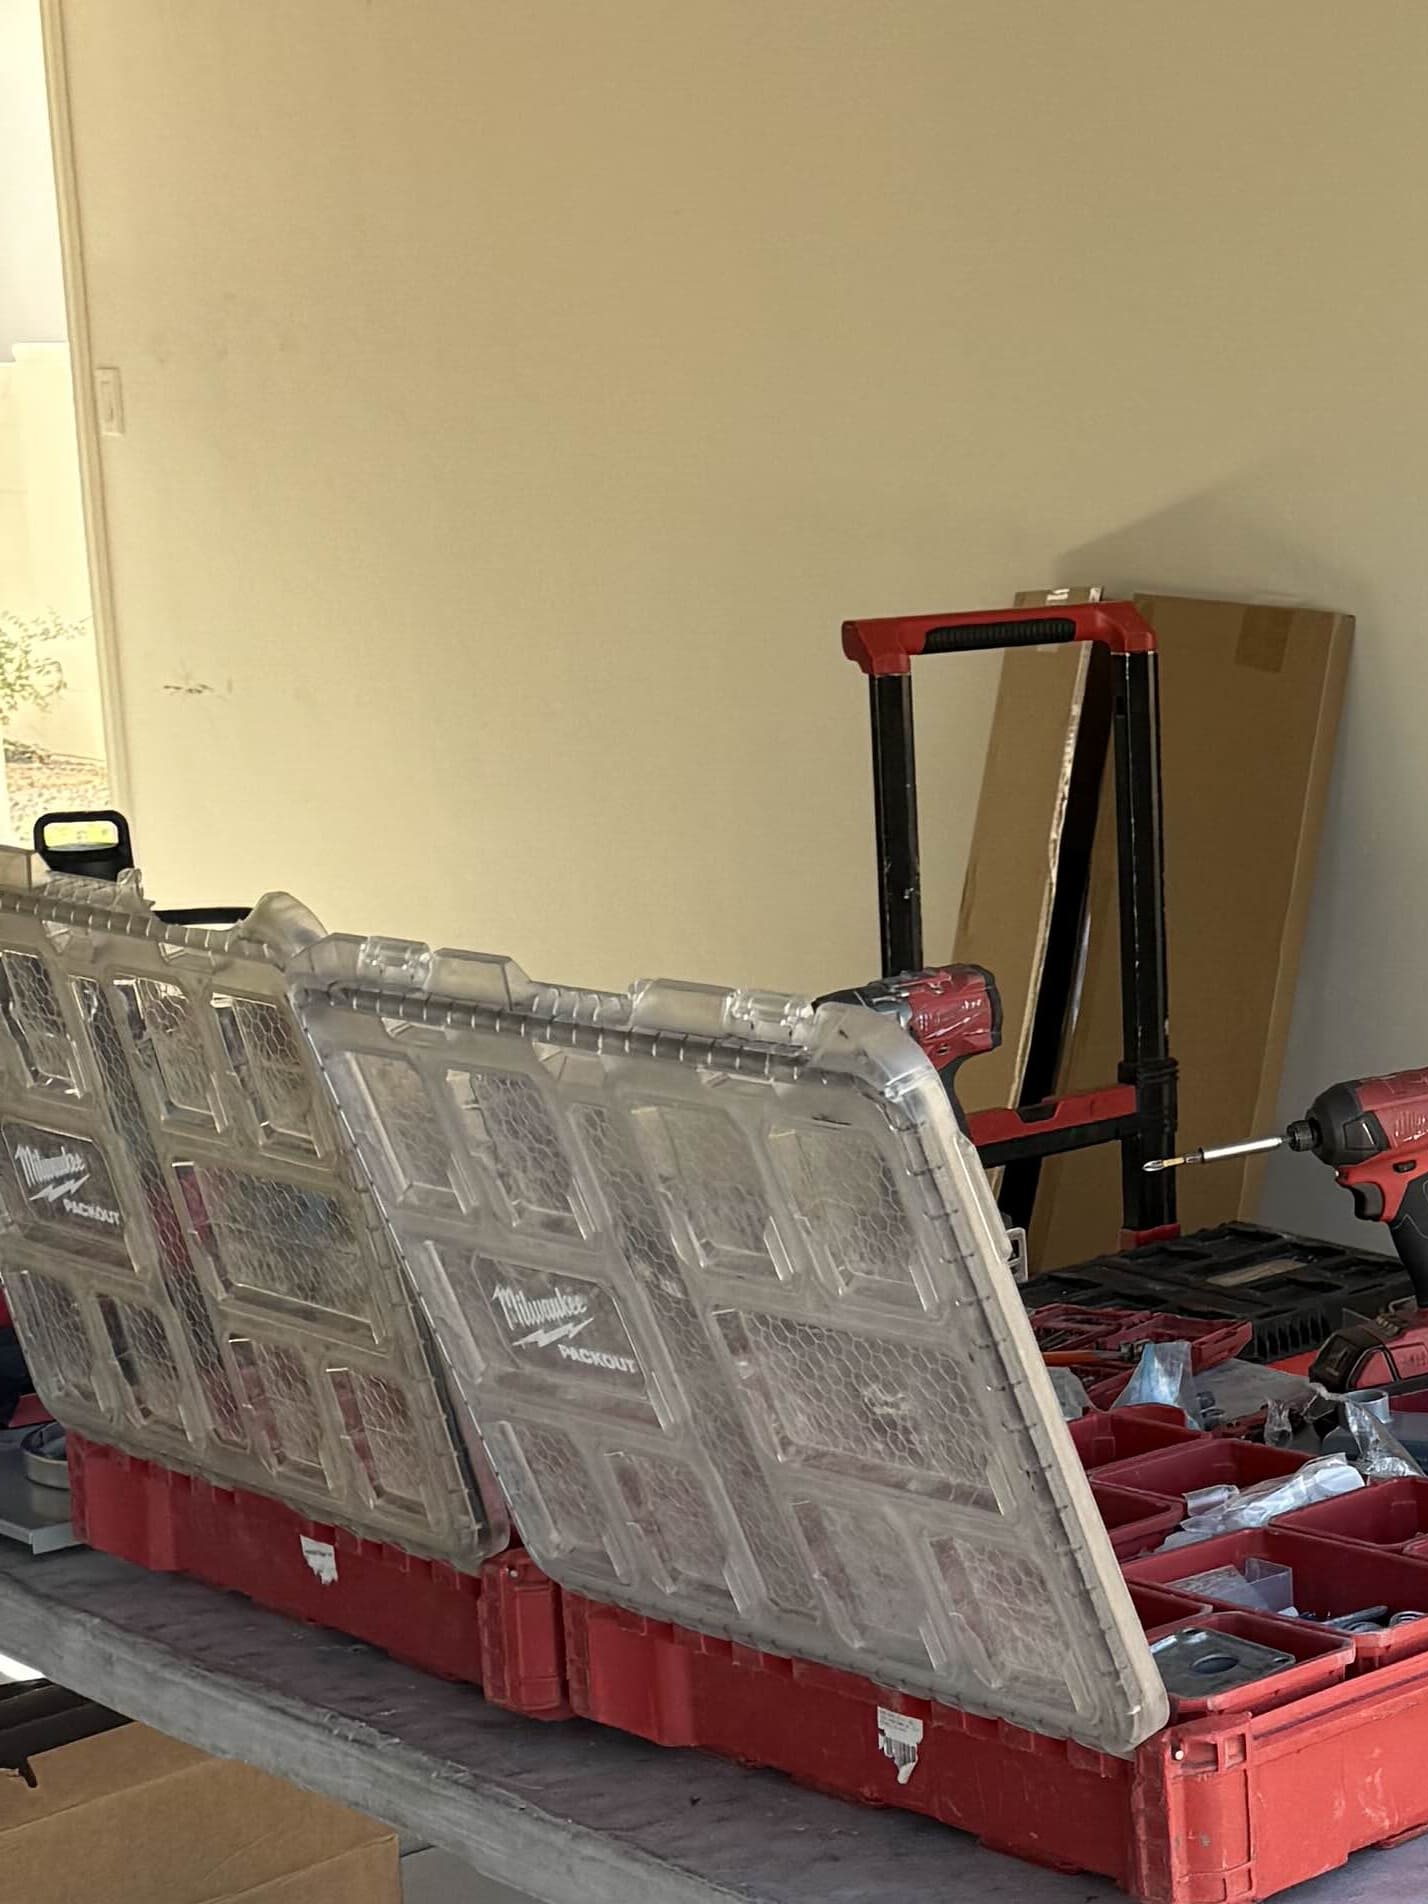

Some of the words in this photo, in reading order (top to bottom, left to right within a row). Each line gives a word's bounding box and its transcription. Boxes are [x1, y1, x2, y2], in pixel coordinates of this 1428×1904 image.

[63, 1198, 120, 1225] PACKOUT
[490, 1283, 588, 1331] Milwaukee
[557, 1343, 637, 1374] PACKOUT
